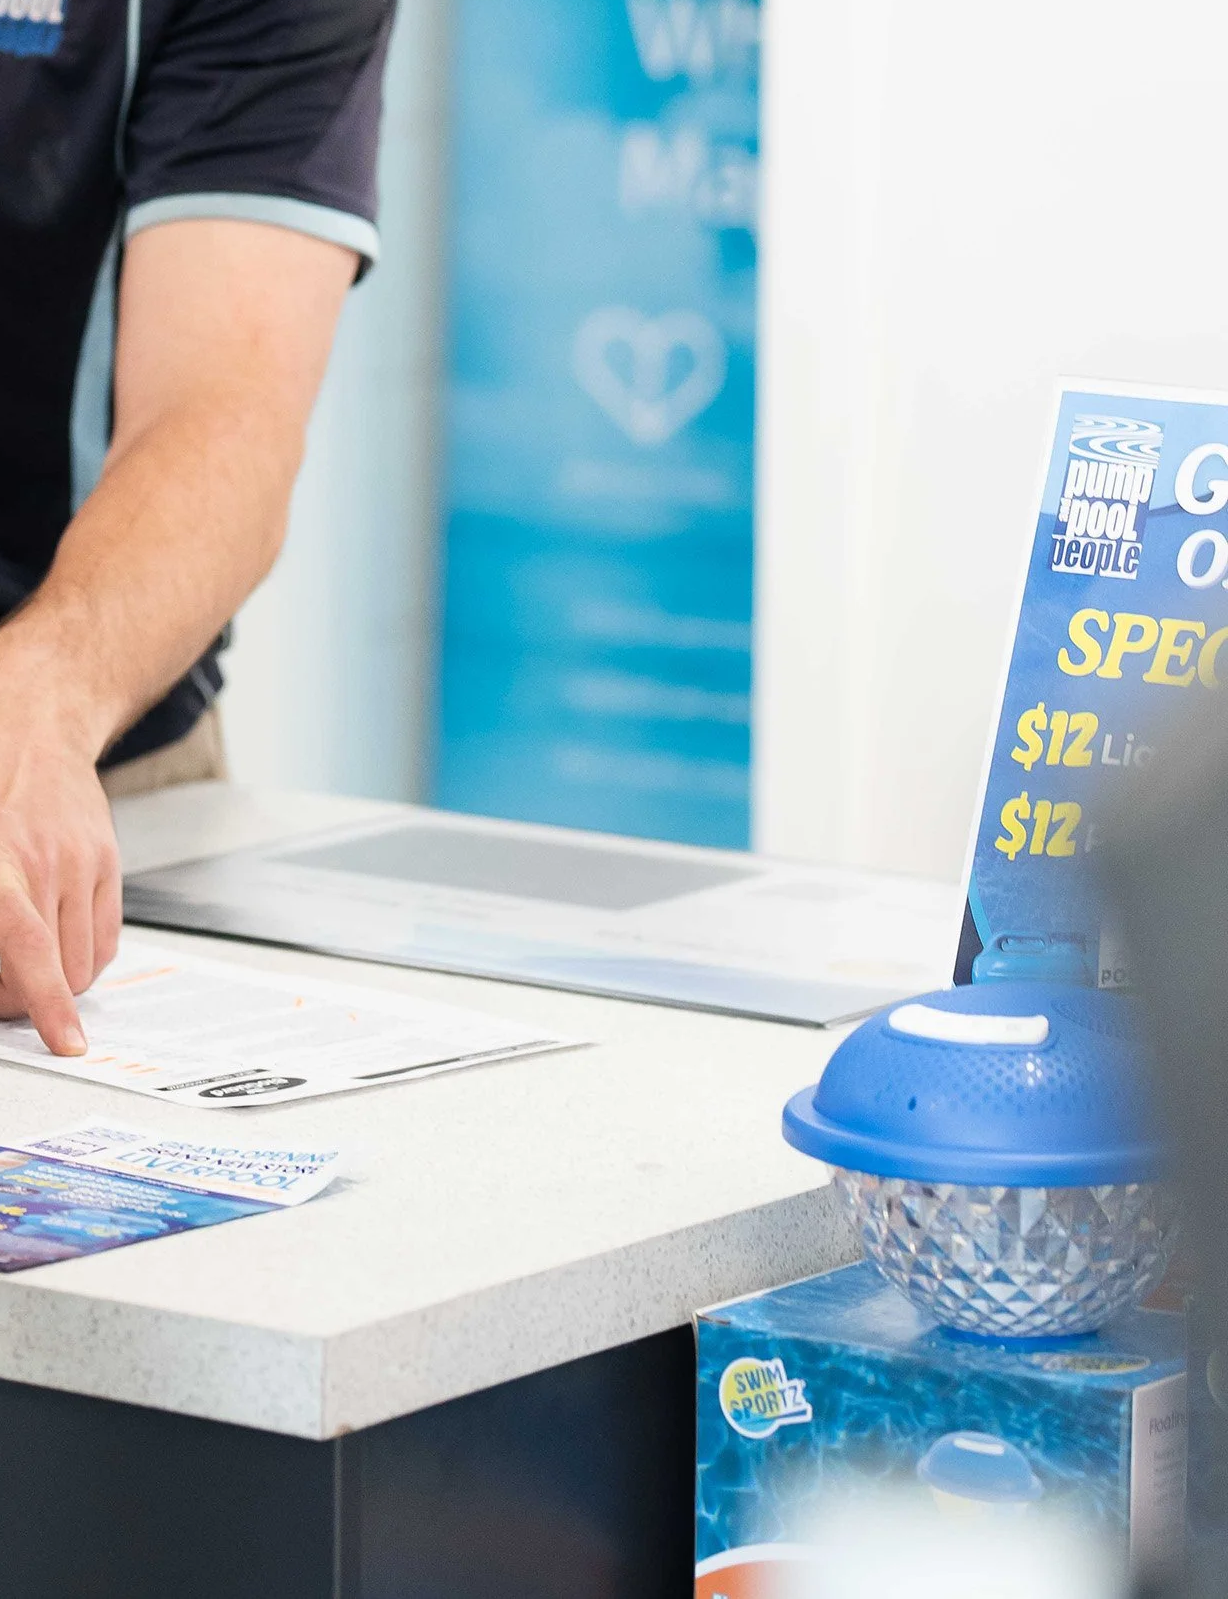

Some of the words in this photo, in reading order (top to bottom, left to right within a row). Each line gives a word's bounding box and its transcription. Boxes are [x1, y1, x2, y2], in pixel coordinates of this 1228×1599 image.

[1063, 459, 1154, 506] pump
[1051, 538, 1139, 577] people
[1010, 702, 1100, 772] $12
[994, 791, 1084, 862] $12
[115, 1152, 301, 1191] LIVERPOOL
[733, 1365, 784, 1395] SWIM
[730, 1385, 803, 1420] SPORTZ
